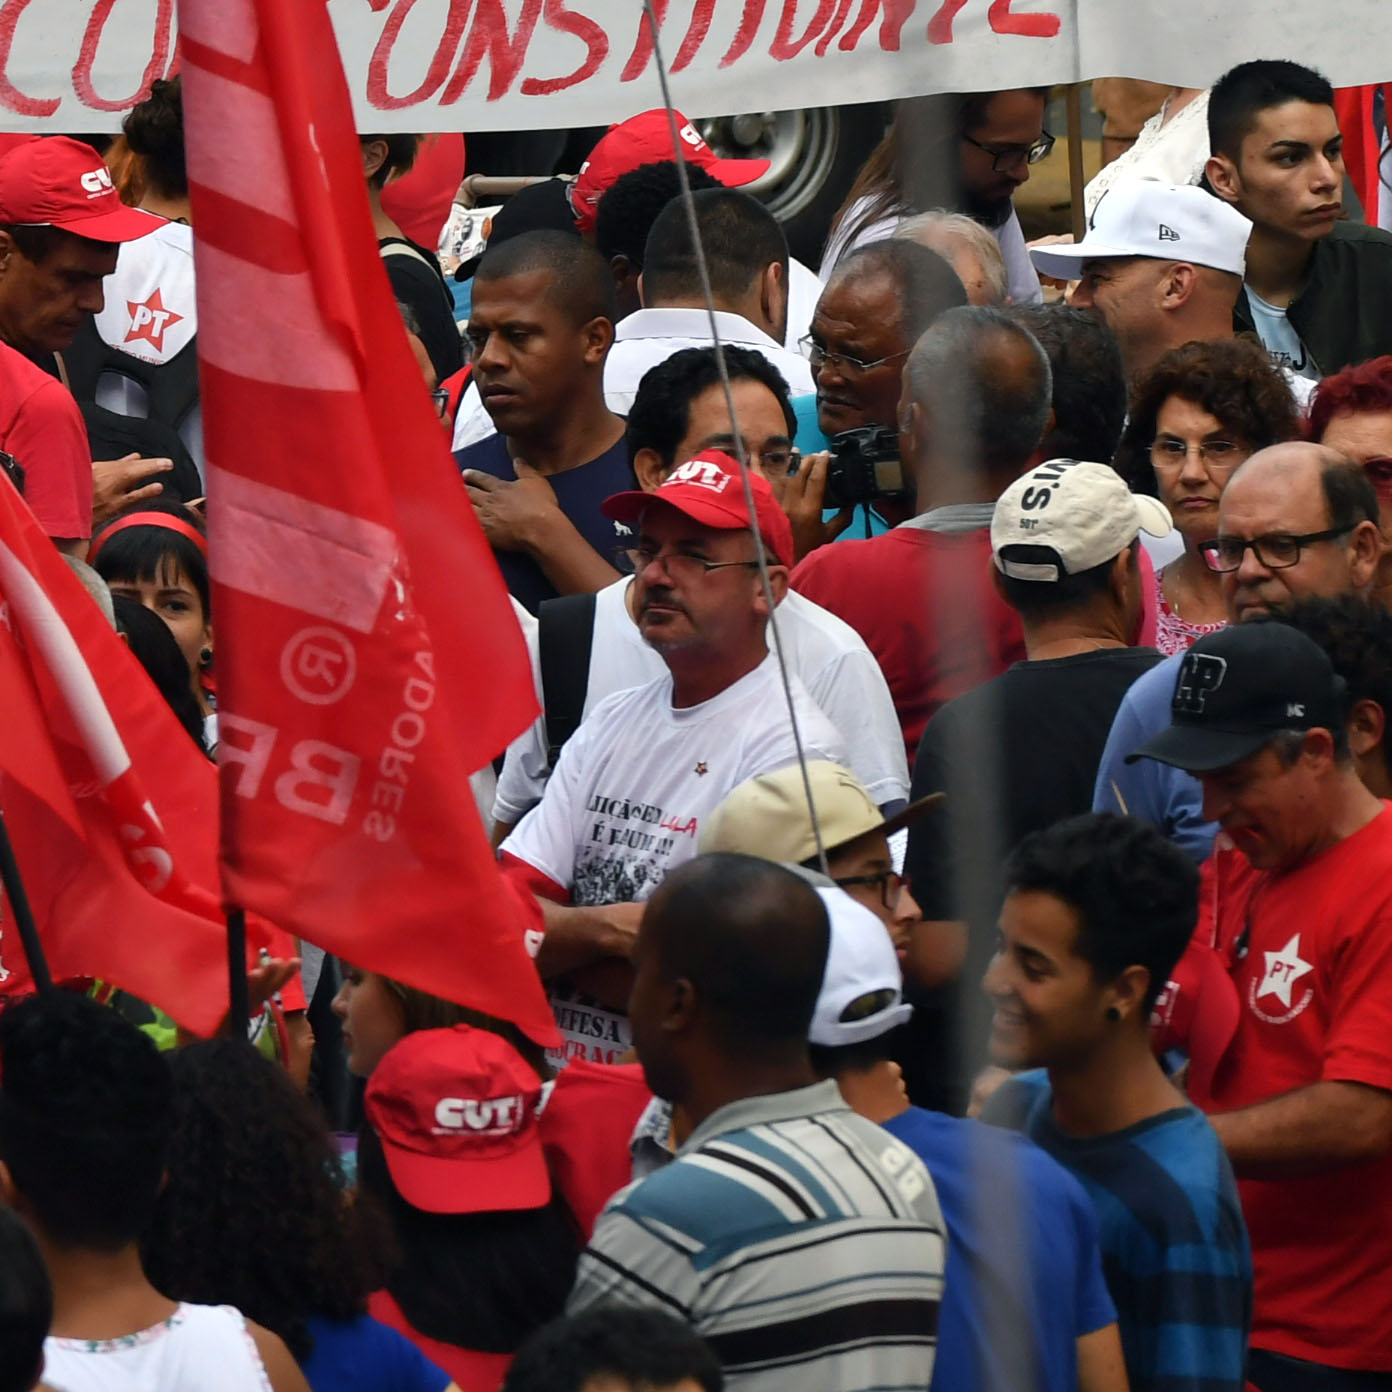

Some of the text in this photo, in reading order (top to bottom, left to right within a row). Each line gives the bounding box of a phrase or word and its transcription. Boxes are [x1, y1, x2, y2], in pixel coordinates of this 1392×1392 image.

[131, 305, 170, 338] PT
[591, 819, 605, 844] É
[1270, 959, 1298, 984] PT
[557, 1007, 622, 1044] EFESA
[435, 1094, 516, 1131] CUT
